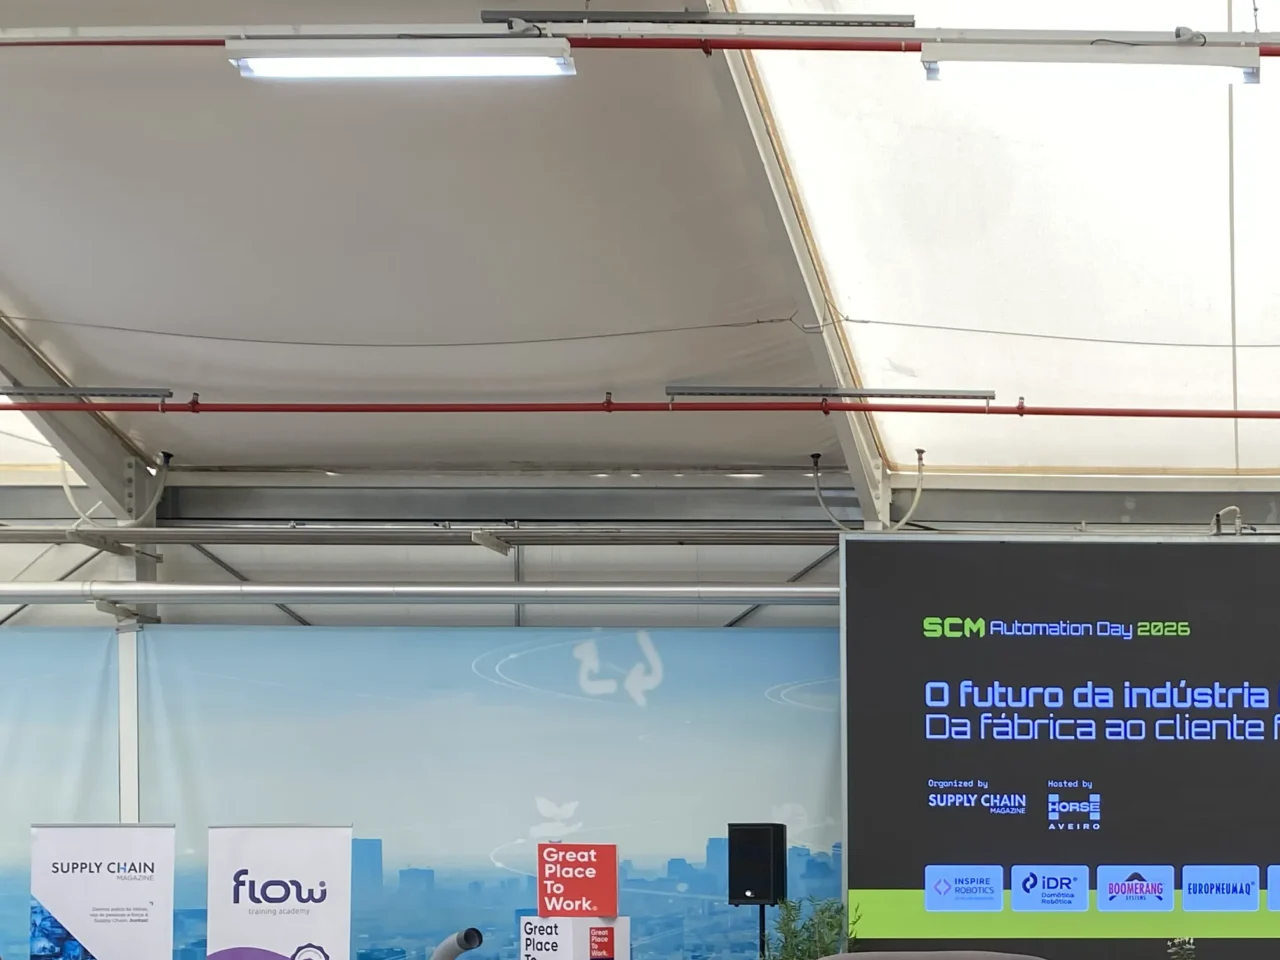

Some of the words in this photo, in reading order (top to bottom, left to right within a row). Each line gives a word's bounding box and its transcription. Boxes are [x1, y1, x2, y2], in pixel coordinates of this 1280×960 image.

[923, 617, 985, 638] SCM
[990, 620, 1092, 636] Automation
[1097, 621, 1133, 640] Day
[1137, 622, 1191, 636] 2026
[925, 682, 950, 707] O
[959, 680, 1063, 708] futuro
[1073, 681, 1114, 708] da
[1124, 679, 1269, 708] indústria
[925, 714, 971, 740] Da
[980, 713, 1096, 740] fábrica
[1105, 719, 1146, 740] ao
[1155, 713, 1265, 740] cliente
[928, 779, 974, 789] Organized
[977, 779, 989, 789] by
[1048, 780, 1079, 788] Hosted
[1082, 780, 1093, 789] by
[928, 794, 978, 807] SUPPLY
[981, 794, 1027, 807] CHAIN
[542, 847, 597, 862] Great
[51, 862, 103, 874] SUPPLY
[106, 862, 155, 874] CHAIN
[544, 863, 597, 878] Place
[543, 880, 565, 894] To
[954, 877, 991, 885] INSPIRE
[954, 886, 995, 894] ROBOTICS
[1108, 882, 1164, 895] BOOMERANG
[248, 908, 276, 916] training
[278, 908, 310, 916] academy
[523, 921, 559, 936] Great
[525, 938, 559, 951] Place
